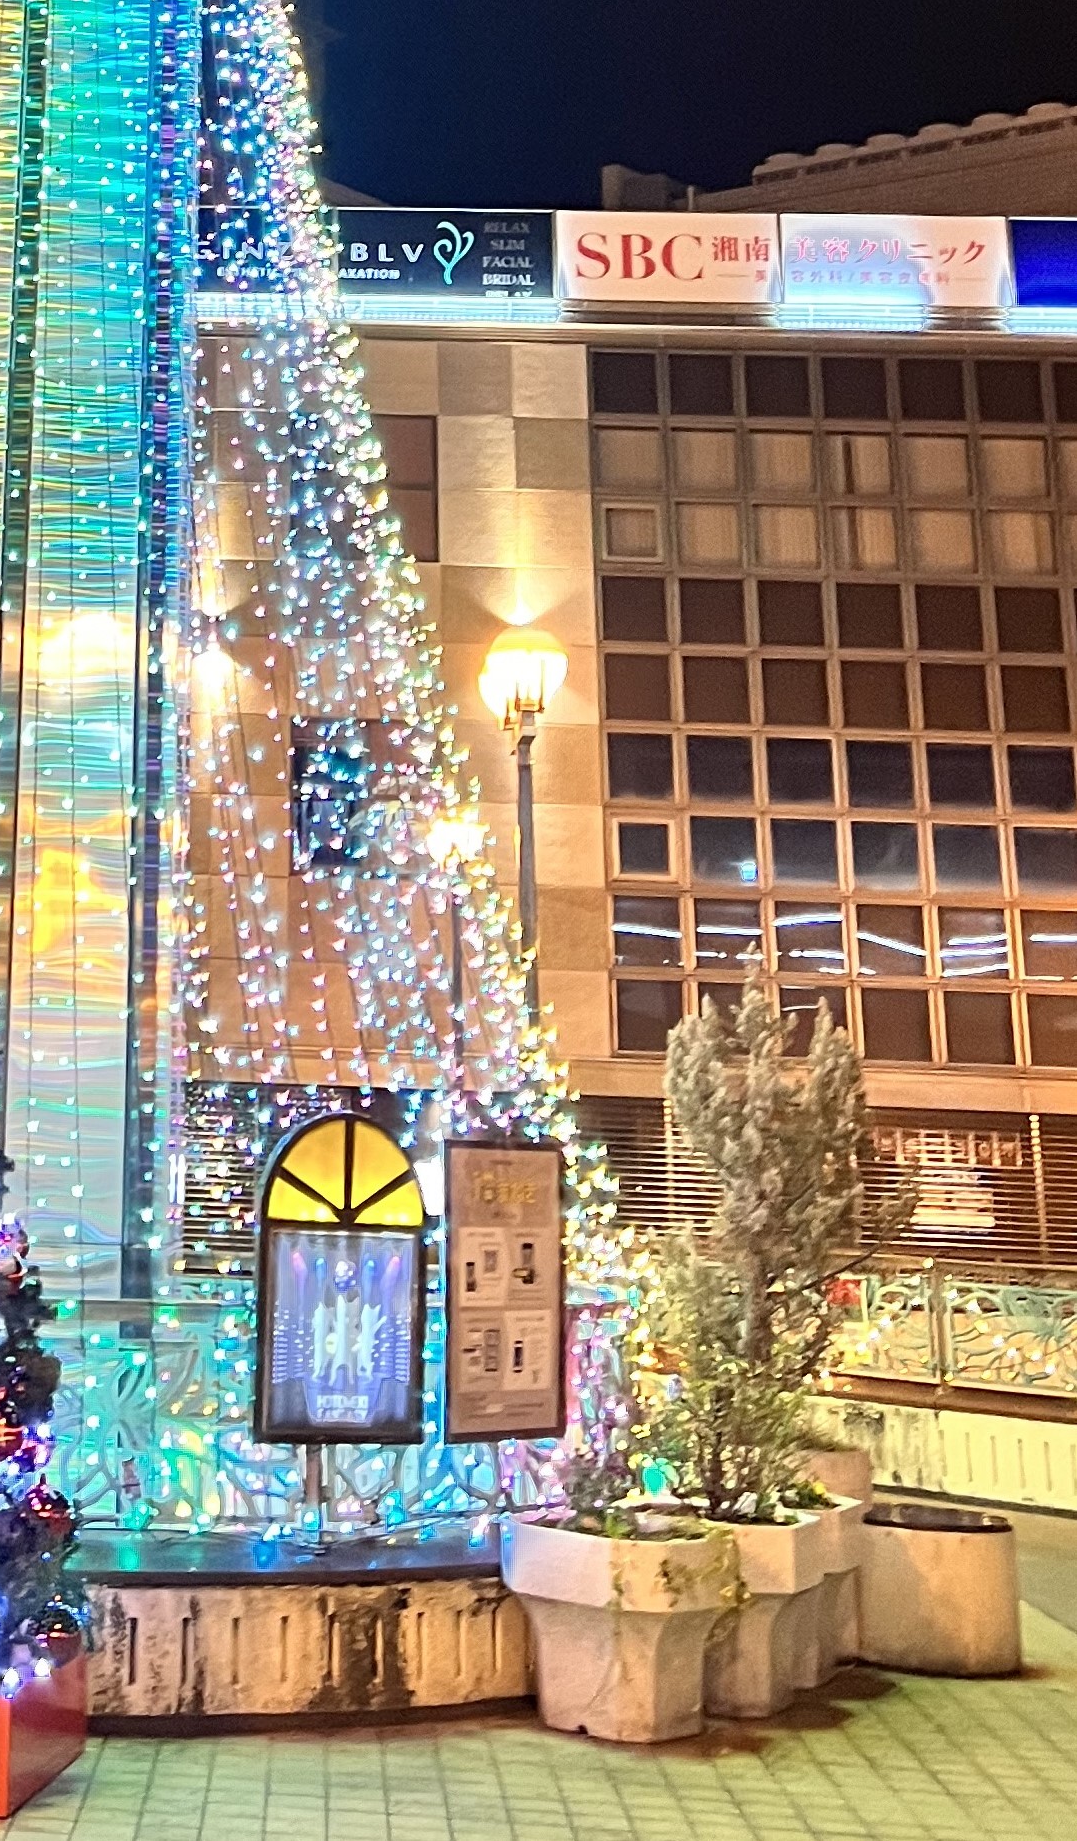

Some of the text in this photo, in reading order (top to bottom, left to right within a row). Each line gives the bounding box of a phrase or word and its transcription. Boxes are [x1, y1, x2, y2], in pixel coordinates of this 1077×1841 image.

[482, 255, 534, 268] FACIAL
[575, 232, 986, 281] SBC 湘南 美容クリニック
[481, 273, 536, 285] BRIDAL
